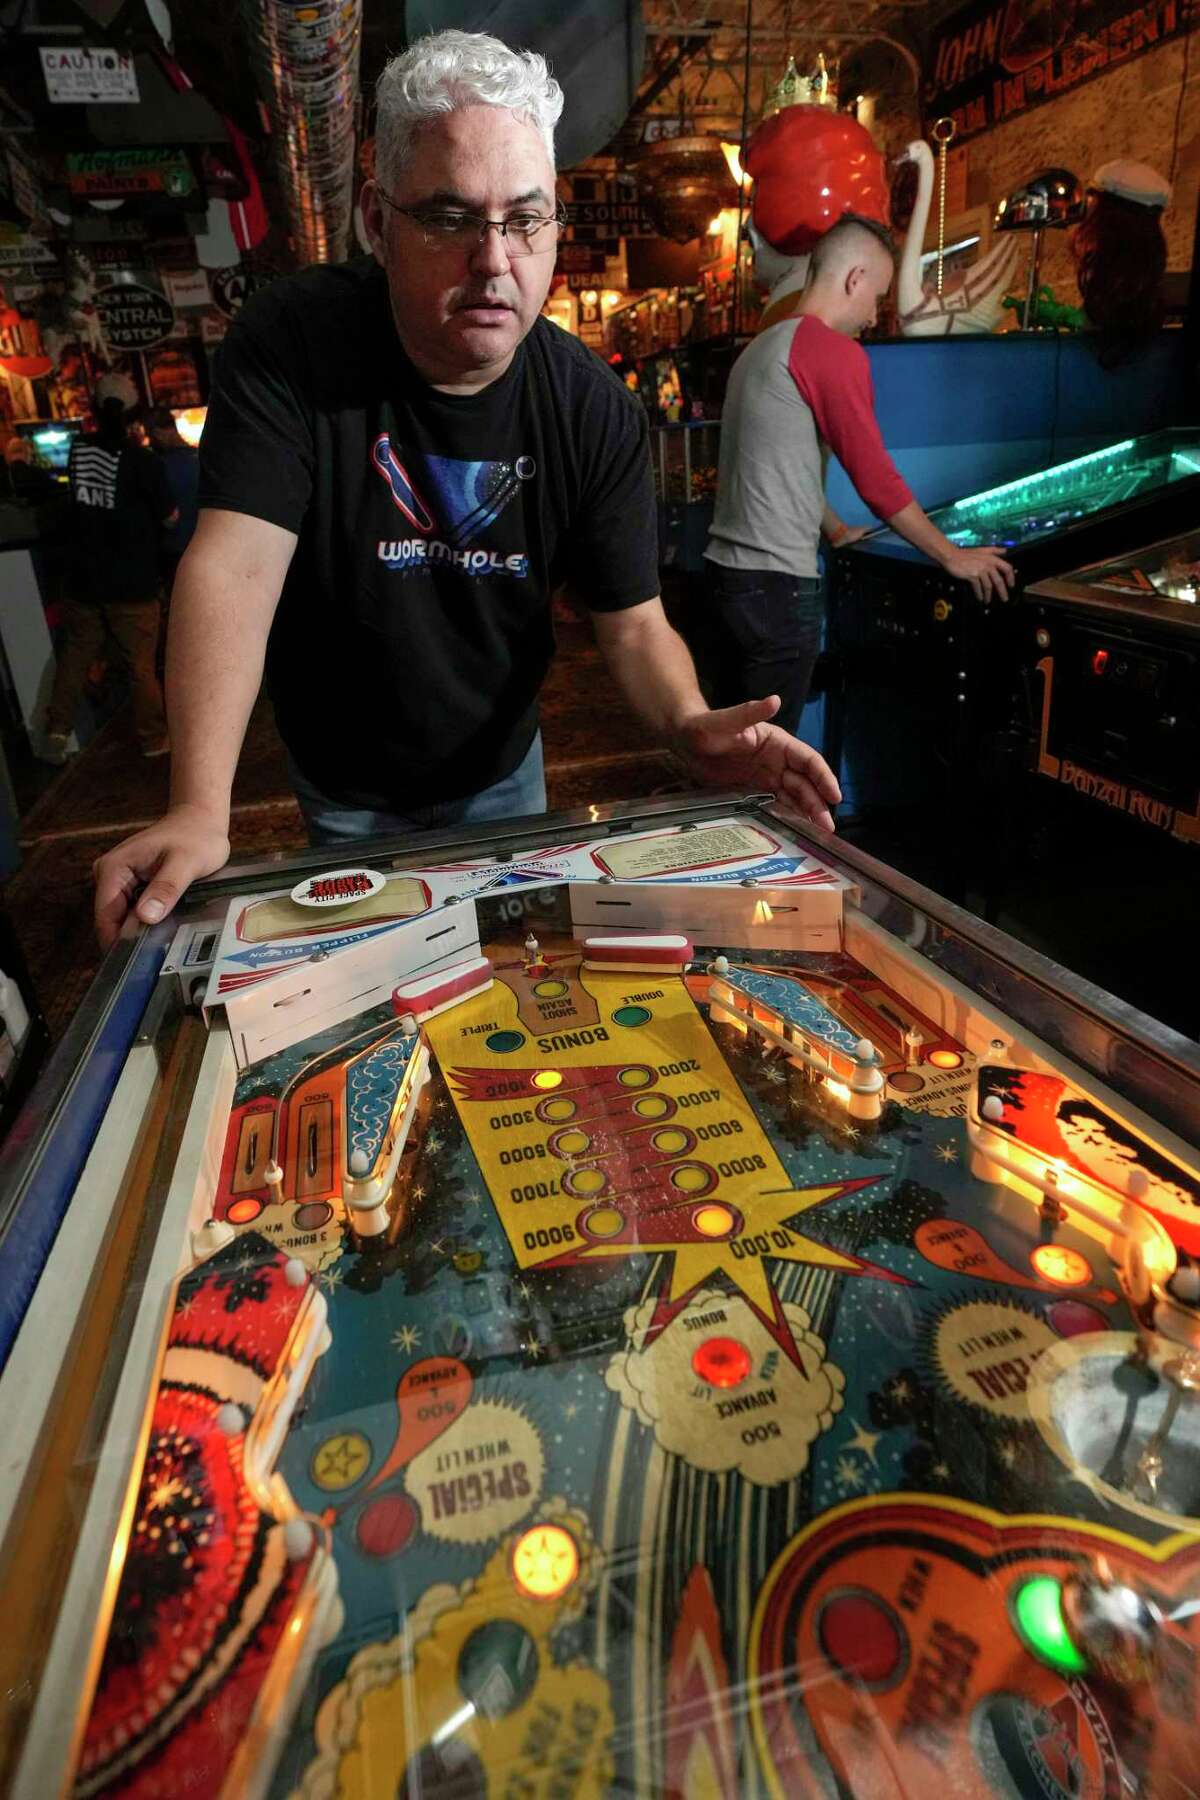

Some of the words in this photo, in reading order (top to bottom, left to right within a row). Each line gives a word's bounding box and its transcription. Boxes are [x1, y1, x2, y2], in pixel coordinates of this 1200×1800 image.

[45, 53, 130, 71] CAUTION
[377, 538, 527, 575] WORMHOLE
[690, 872, 738, 884] BUTTON
[743, 861, 790, 877] FLIPPER
[313, 895, 335, 903] CITY
[337, 889, 367, 900] SPACE
[248, 945, 304, 960] BUTTON
[311, 932, 369, 952] FLIPPER
[537, 998, 573, 1013] AGAIN
[619, 989, 665, 1006] DOUBLE
[540, 1006, 578, 1021] SHOOT
[459, 1022, 500, 1037] TRIPLE
[535, 1027, 610, 1055] BONUS
[658, 1058, 701, 1079] 2000
[485, 1080, 528, 1100] 1000
[677, 1086, 721, 1109] 4000
[902, 1088, 945, 1107] ADVANCE
[489, 1109, 534, 1131] 3000
[695, 1119, 744, 1142] 6000
[498, 1142, 546, 1165] 5000
[718, 1153, 768, 1180] 8000
[510, 1179, 560, 1204] 7000
[319, 1231, 328, 1243] 3
[523, 1223, 575, 1251] 9000
[728, 1229, 796, 1261] 10,000
[681, 1308, 729, 1334] BONUS
[957, 1335, 982, 1359] LIT
[982, 1326, 1026, 1348] WHEN
[406, 1365, 460, 1387] ADVANCE
[688, 1385, 713, 1402] LIT
[712, 1388, 779, 1420] ADVANCE
[415, 1401, 459, 1422] 500
[739, 1418, 783, 1447] 500
[435, 1450, 461, 1472] LIT
[463, 1438, 513, 1465] WHEN
[425, 1460, 533, 1521] SPECIAL
